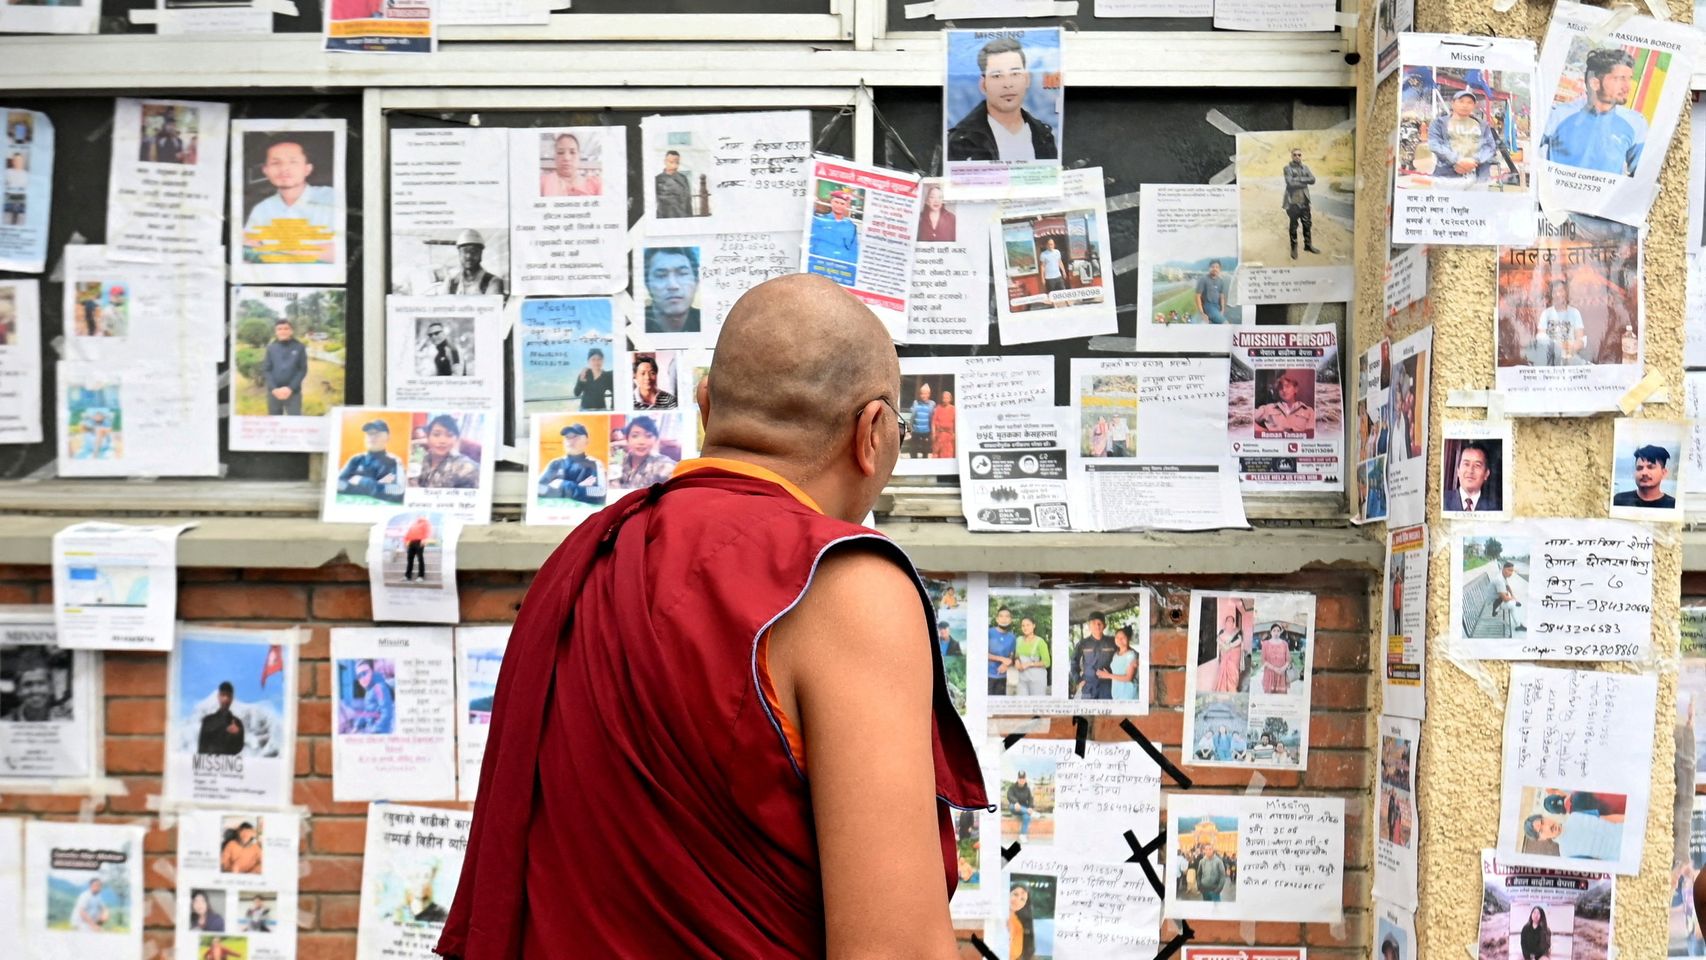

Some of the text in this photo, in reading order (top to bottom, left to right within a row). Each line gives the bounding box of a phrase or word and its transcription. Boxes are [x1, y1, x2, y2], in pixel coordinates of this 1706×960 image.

[974, 31, 1025, 40] MISSING
[1615, 32, 1648, 45] RASUWA
[1650, 39, 1681, 51] BORDER
[1451, 51, 1485, 64] Missing
[1554, 167, 1577, 178] found
[1577, 171, 1606, 184] contact
[1240, 332, 1331, 347] MISSING PERSON
[1021, 743, 1131, 761] Missing Missing
[192, 754, 244, 773] MISSING
[1266, 799, 1310, 814] Missing
